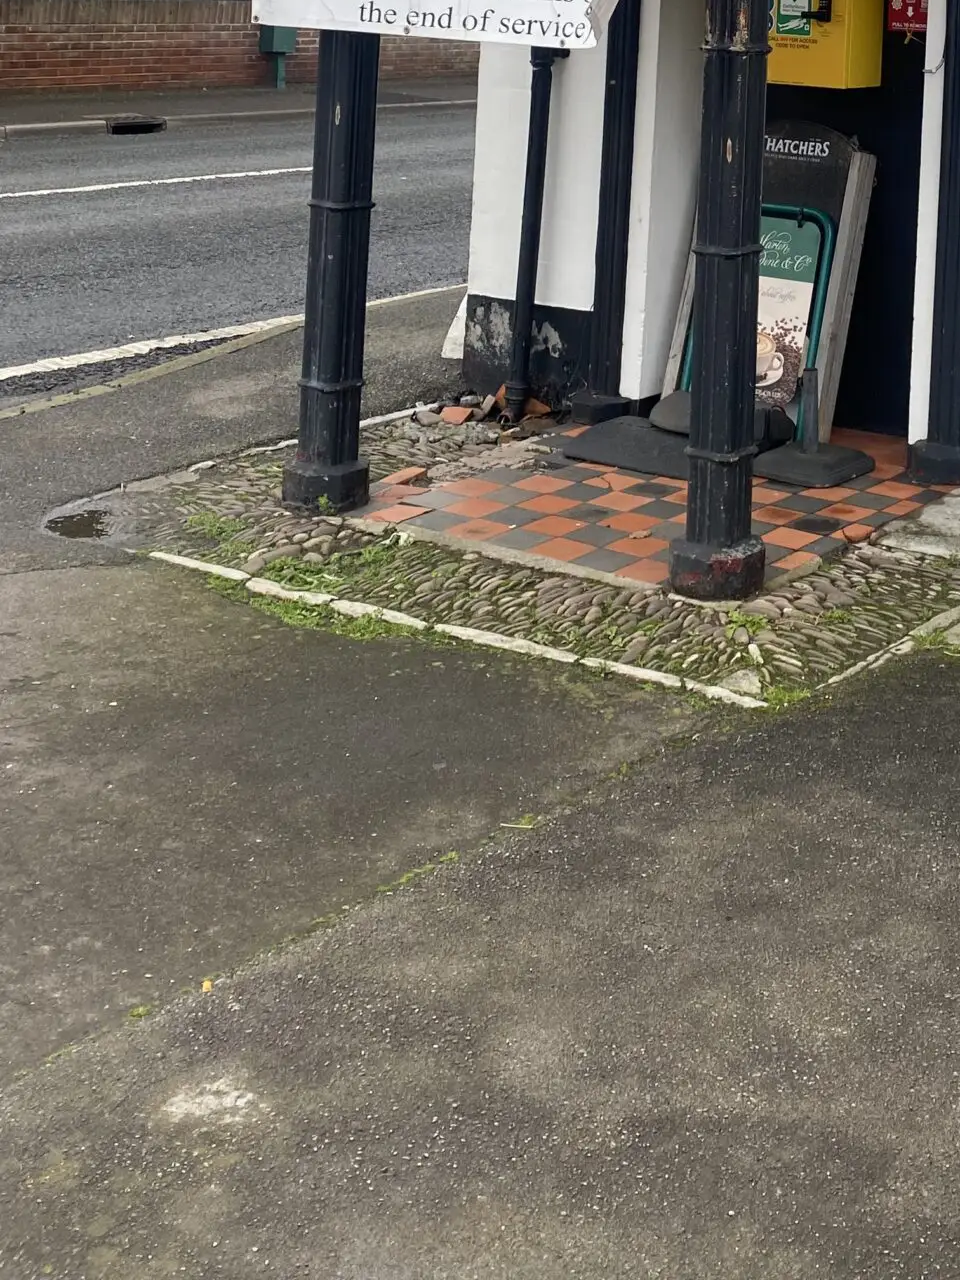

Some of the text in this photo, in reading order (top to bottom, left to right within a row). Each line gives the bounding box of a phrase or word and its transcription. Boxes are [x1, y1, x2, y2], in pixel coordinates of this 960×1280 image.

[358, 1, 594, 45] the end of service)
[764, 136, 830, 157] HATCHERS
